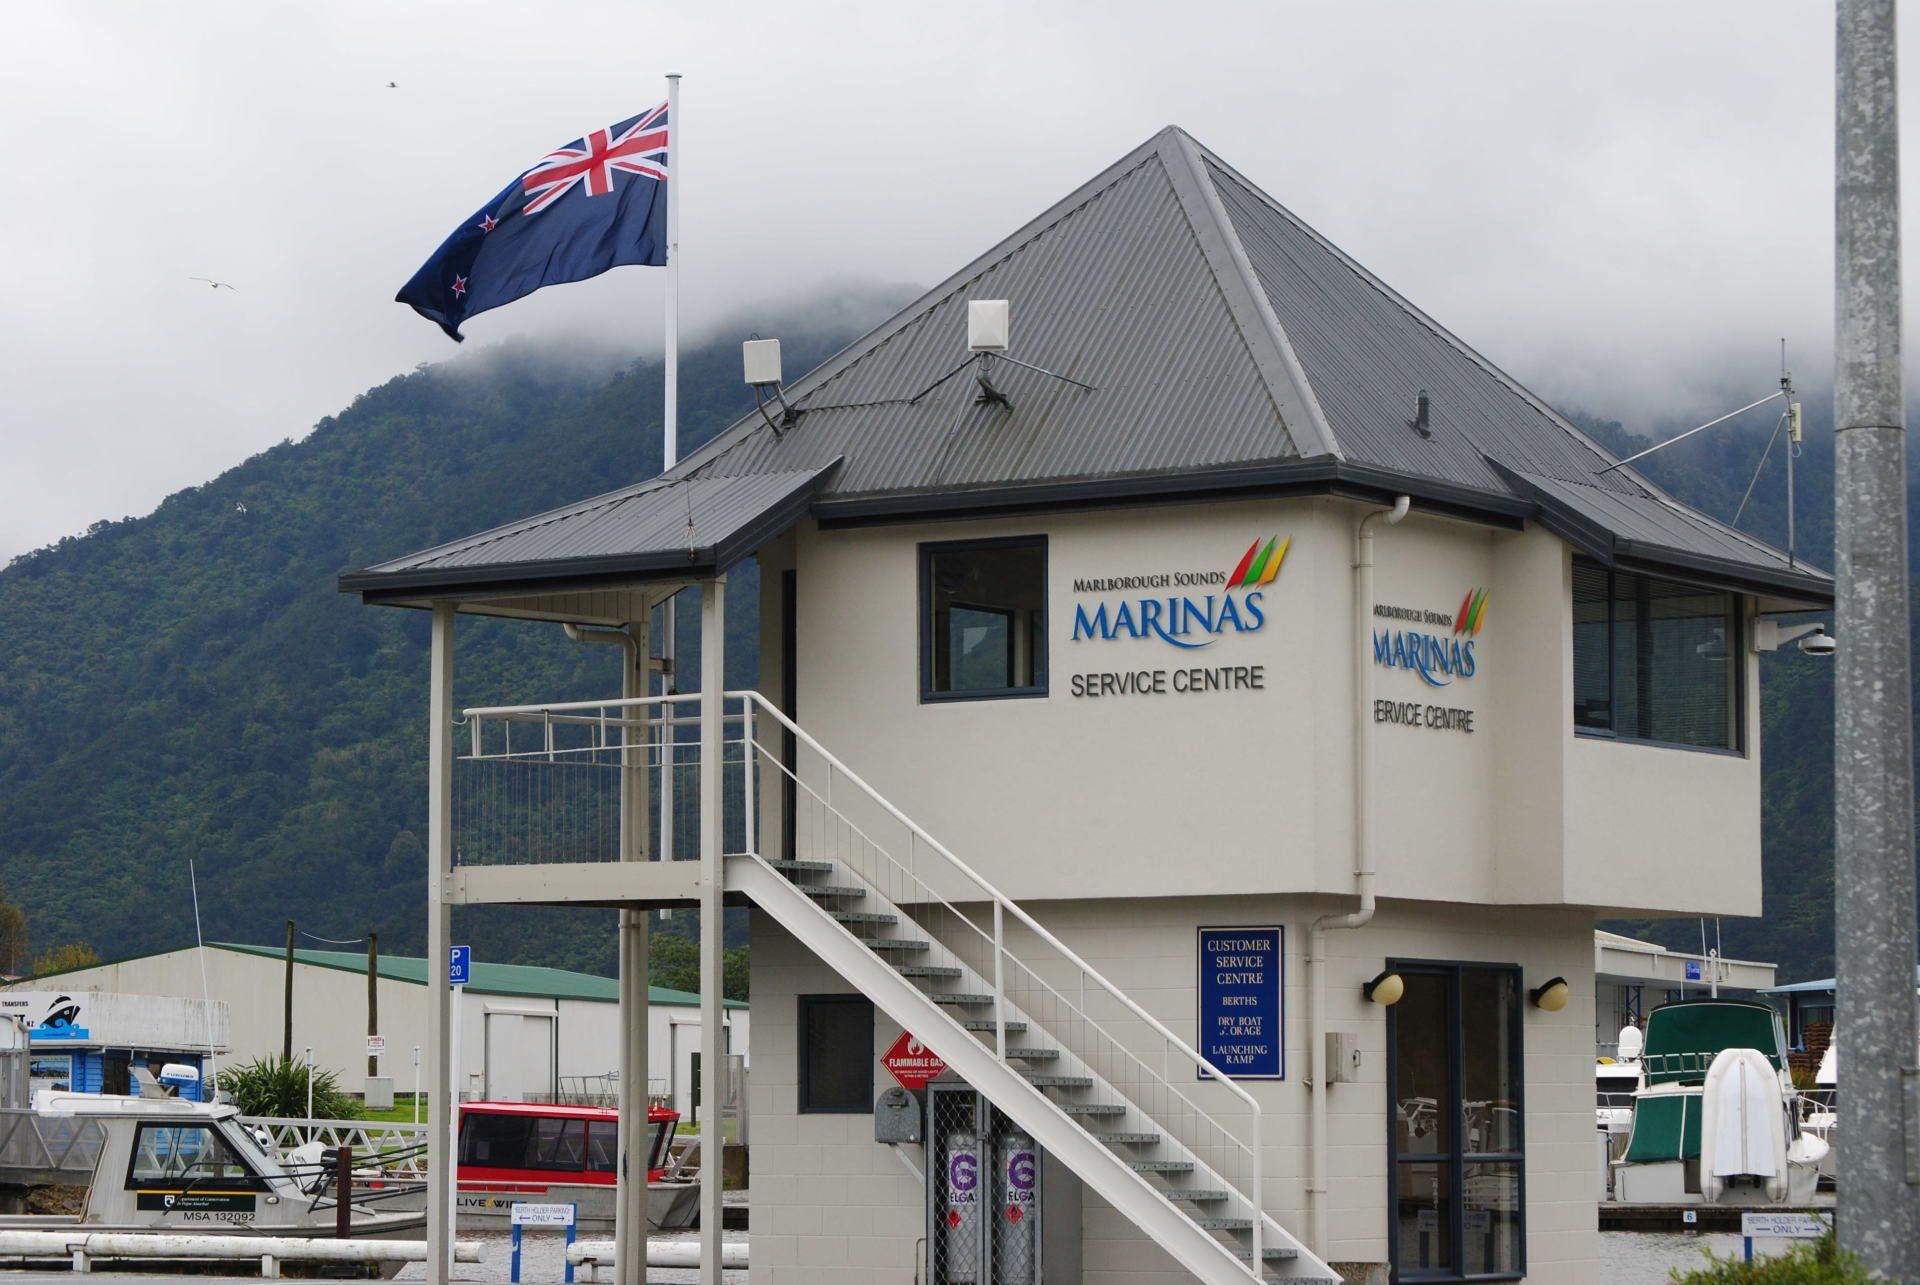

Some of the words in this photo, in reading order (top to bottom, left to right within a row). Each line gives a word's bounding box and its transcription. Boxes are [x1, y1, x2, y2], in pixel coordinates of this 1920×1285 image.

[1073, 575, 1169, 592] MARLBOROUGH
[1174, 571, 1226, 586] SOUNDS
[1070, 592, 1265, 648] MARINAS
[1373, 603, 1422, 622] ARLBOROUGH
[1424, 609, 1453, 626] SOUNDS
[1373, 627, 1475, 686] MARINAS
[1071, 670, 1166, 697] SERVICE
[1173, 665, 1264, 693] CENTRE
[1373, 699, 1422, 726] ERVICE
[1425, 705, 1474, 732] CENTRE
[1207, 939, 1271, 951] CUSTOMER
[451, 949, 461, 963] P
[1216, 956, 1264, 968] SERVICE
[450, 965, 462, 976] 20
[1216, 972, 1263, 985] CENTRE
[1222, 996, 1257, 1006] BERTHS
[1218, 1016, 1235, 1026] DRY
[1239, 1016, 1262, 1025] BOAT
[1212, 1045, 1268, 1055] LAUNCHING
[889, 1058, 929, 1067] FLAMMABLE
[930, 1057, 944, 1067] GAS
[1225, 1054, 1255, 1064] RAMP
[950, 1192, 976, 1203] ELGA
[1008, 1191, 1035, 1201] ELGA
[456, 1198, 486, 1207] LIVE
[183, 1212, 210, 1221] MSA
[215, 1212, 256, 1221] 132092
[531, 1214, 551, 1222] ONLY
[1686, 1212, 1693, 1221] 6
[1772, 1225, 1801, 1233] ONLY
